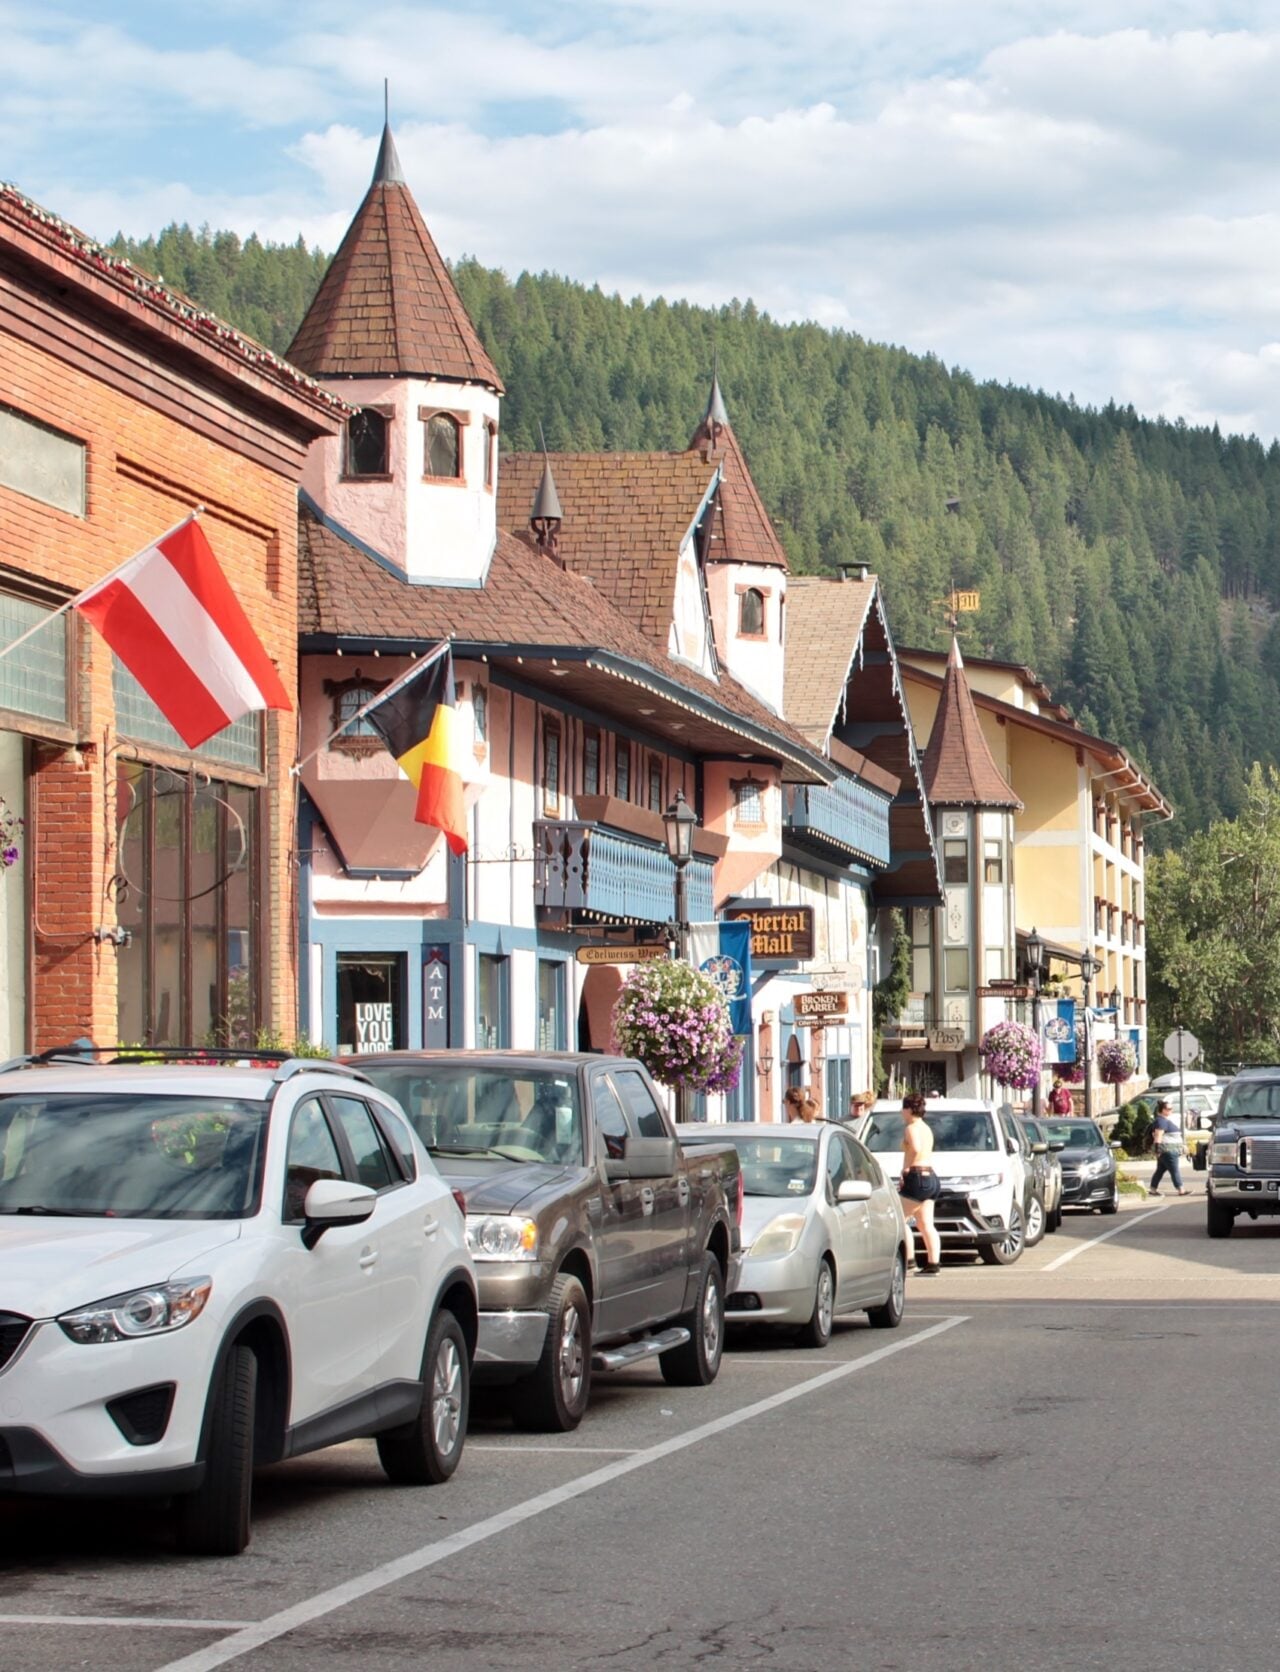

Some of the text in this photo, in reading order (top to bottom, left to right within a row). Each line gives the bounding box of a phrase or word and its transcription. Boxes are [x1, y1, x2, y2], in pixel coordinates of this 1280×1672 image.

[751, 933, 793, 954] Mall
[586, 948, 634, 959] Edelweiss
[428, 966, 444, 1019] ATM
[801, 995, 838, 1004] BROKEN
[356, 1003, 392, 1021] LOVE
[802, 1002, 837, 1013] BARREL
[357, 1021, 392, 1042] YOU
